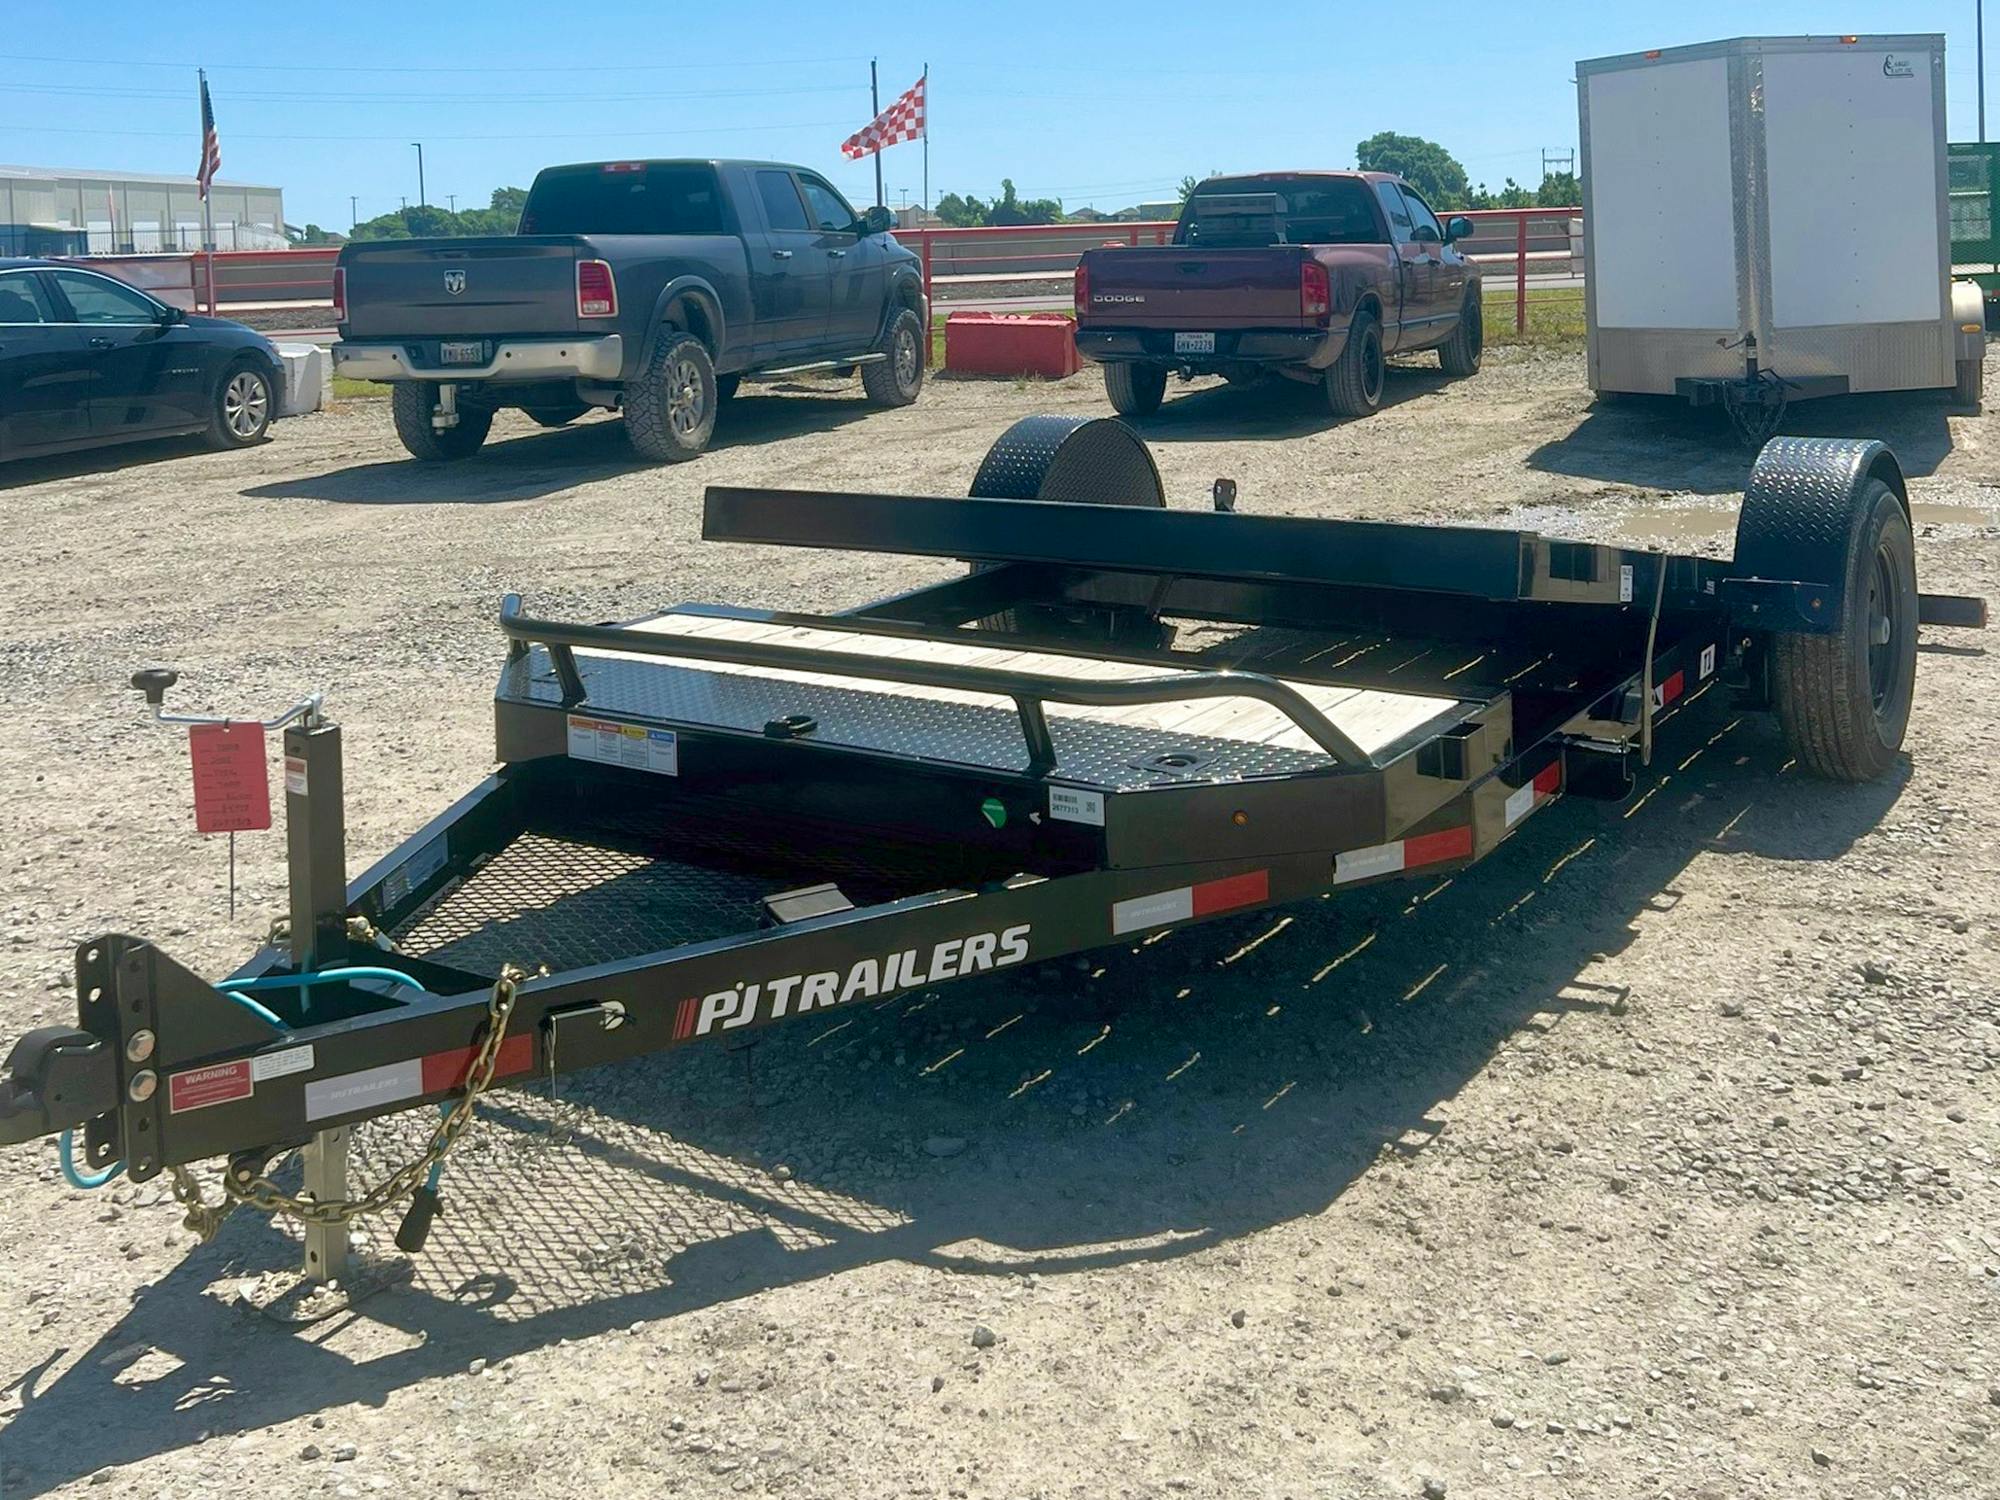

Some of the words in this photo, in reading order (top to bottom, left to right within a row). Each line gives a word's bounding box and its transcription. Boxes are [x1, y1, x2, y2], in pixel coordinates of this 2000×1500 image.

[1094, 295, 1145, 303] DODGE
[695, 981, 760, 1036] PJ
[766, 924, 1032, 1019] TRAILERS
[185, 1065, 238, 1085] WARNING
